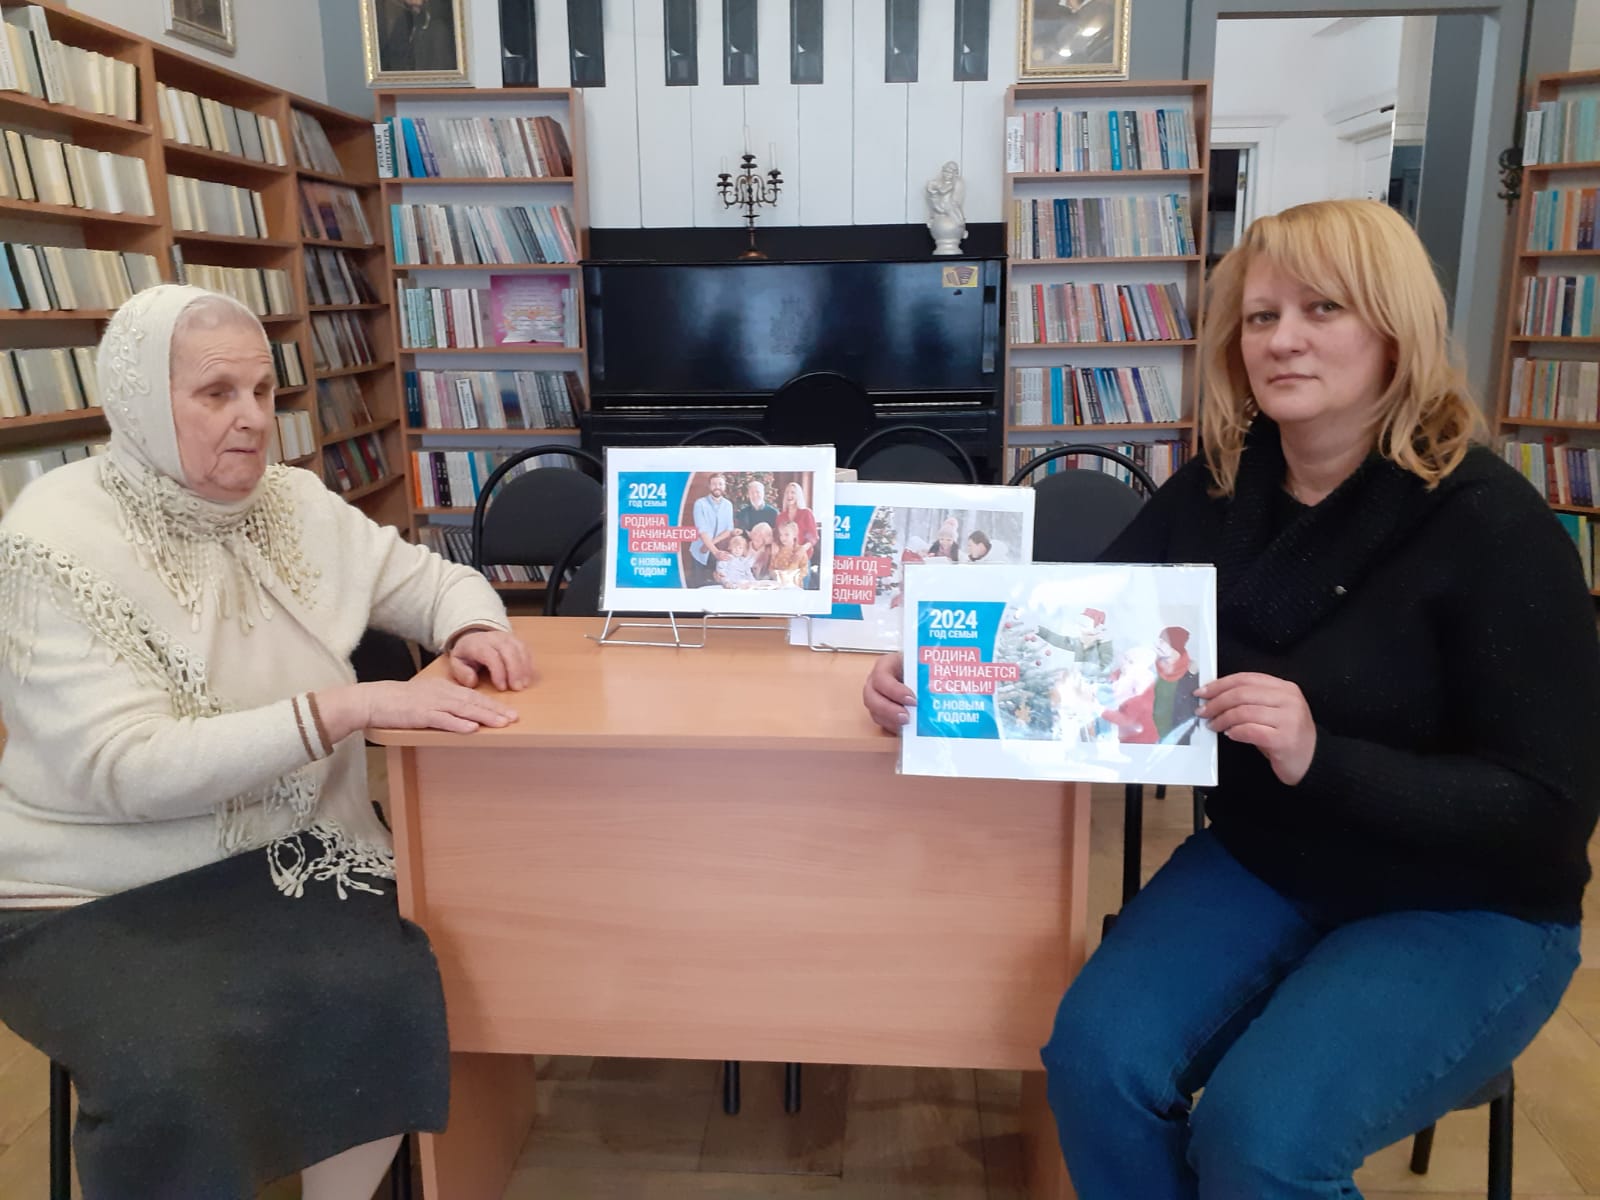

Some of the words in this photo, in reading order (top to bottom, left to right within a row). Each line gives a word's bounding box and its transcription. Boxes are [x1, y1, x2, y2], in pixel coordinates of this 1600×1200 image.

[629, 483, 667, 499] 2024
[628, 500, 643, 508] ГОД
[624, 516, 666, 528] РОДИНА
[834, 515, 851, 532] 24
[632, 529, 697, 539] НАЧИНАЕТСЯ
[632, 541, 639, 551] С
[641, 541, 678, 551] СЕМЬИ!
[630, 557, 637, 566] С
[638, 557, 672, 566] НОВЫМ
[833, 557, 854, 571] ВЫЙ
[856, 560, 878, 574] ГОД
[634, 567, 668, 577] ГОДОМ!
[833, 572, 873, 586] ЕЙНЫЙ
[833, 588, 873, 601] ЗДНИК!
[930, 609, 978, 629] 2024
[929, 630, 946, 639] ГОД
[948, 630, 978, 638] СЕМЬИ
[924, 649, 977, 664] РОДИНА
[934, 665, 1017, 678] НАЧИНАЕТСЯ
[934, 680, 942, 691] С
[945, 680, 992, 692] СЕМЬИ!
[932, 699, 940, 710] С
[942, 699, 985, 711] НОВЫМ
[937, 711, 980, 723] ГОДОМ!
